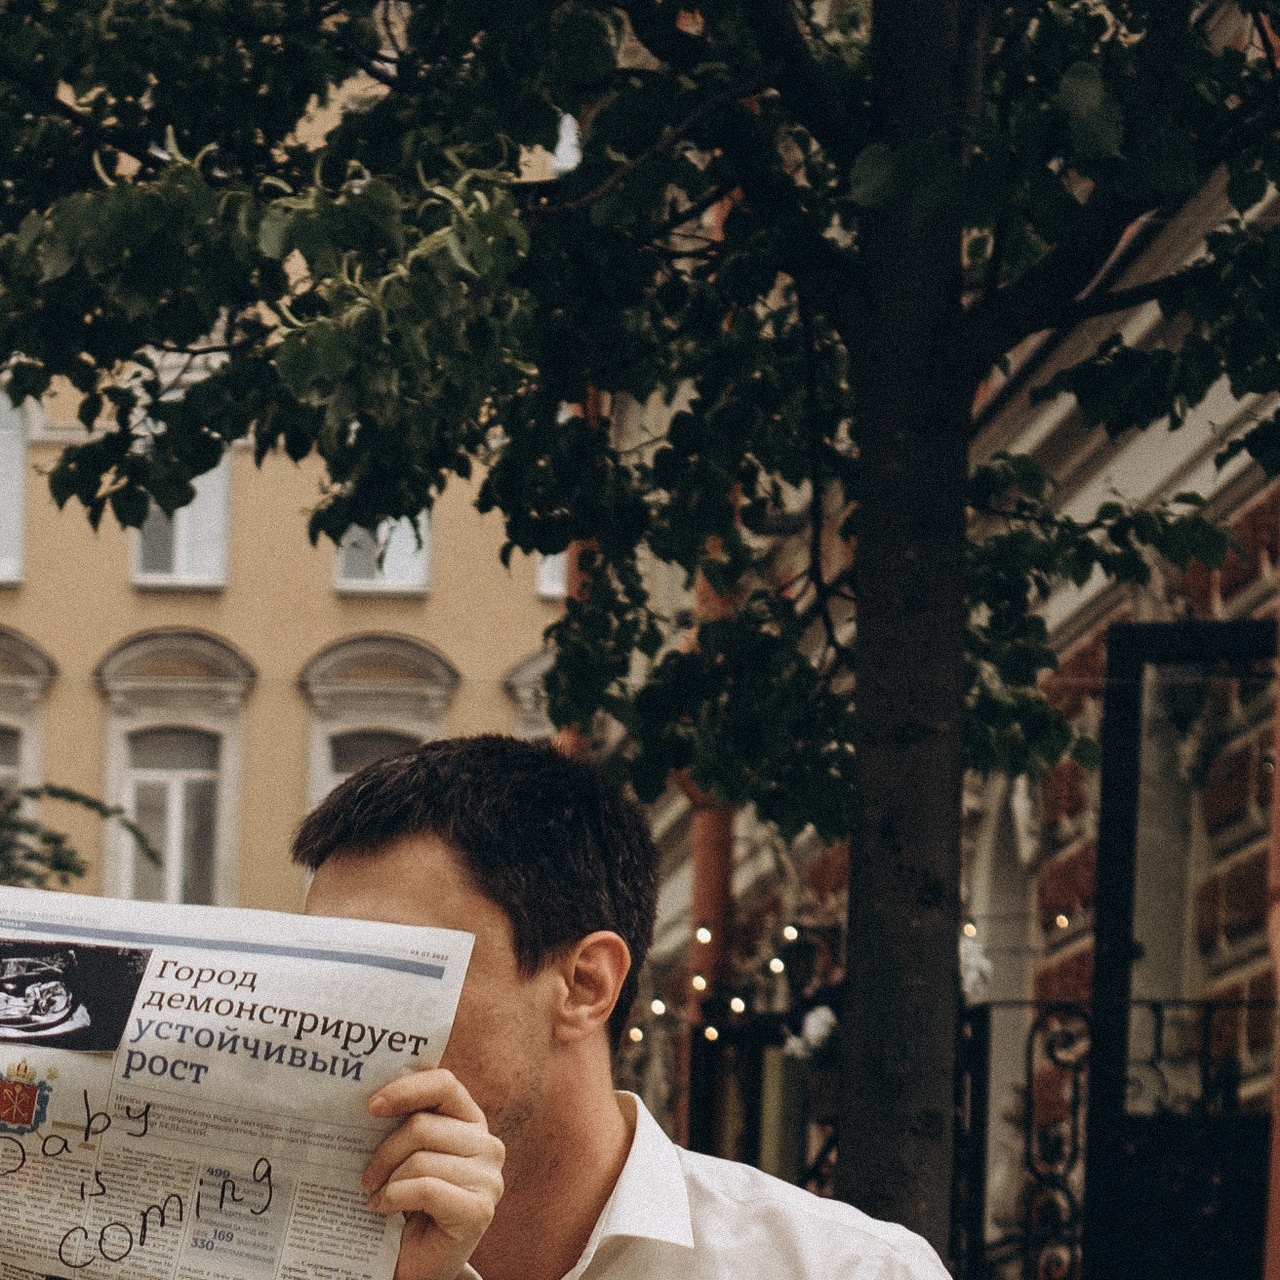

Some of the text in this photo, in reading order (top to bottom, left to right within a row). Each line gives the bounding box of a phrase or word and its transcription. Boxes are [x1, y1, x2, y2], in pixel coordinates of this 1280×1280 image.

[155, 959, 258, 991] Город
[142, 990, 428, 1056] демонстрирует
[130, 1017, 365, 1081] устойчивый
[122, 1049, 209, 1084] рост
[80, 1170, 107, 1200] is
[58, 1157, 273, 1269] coming
[190, 1237, 215, 1251] 330
[213, 1229, 235, 1243] 169
